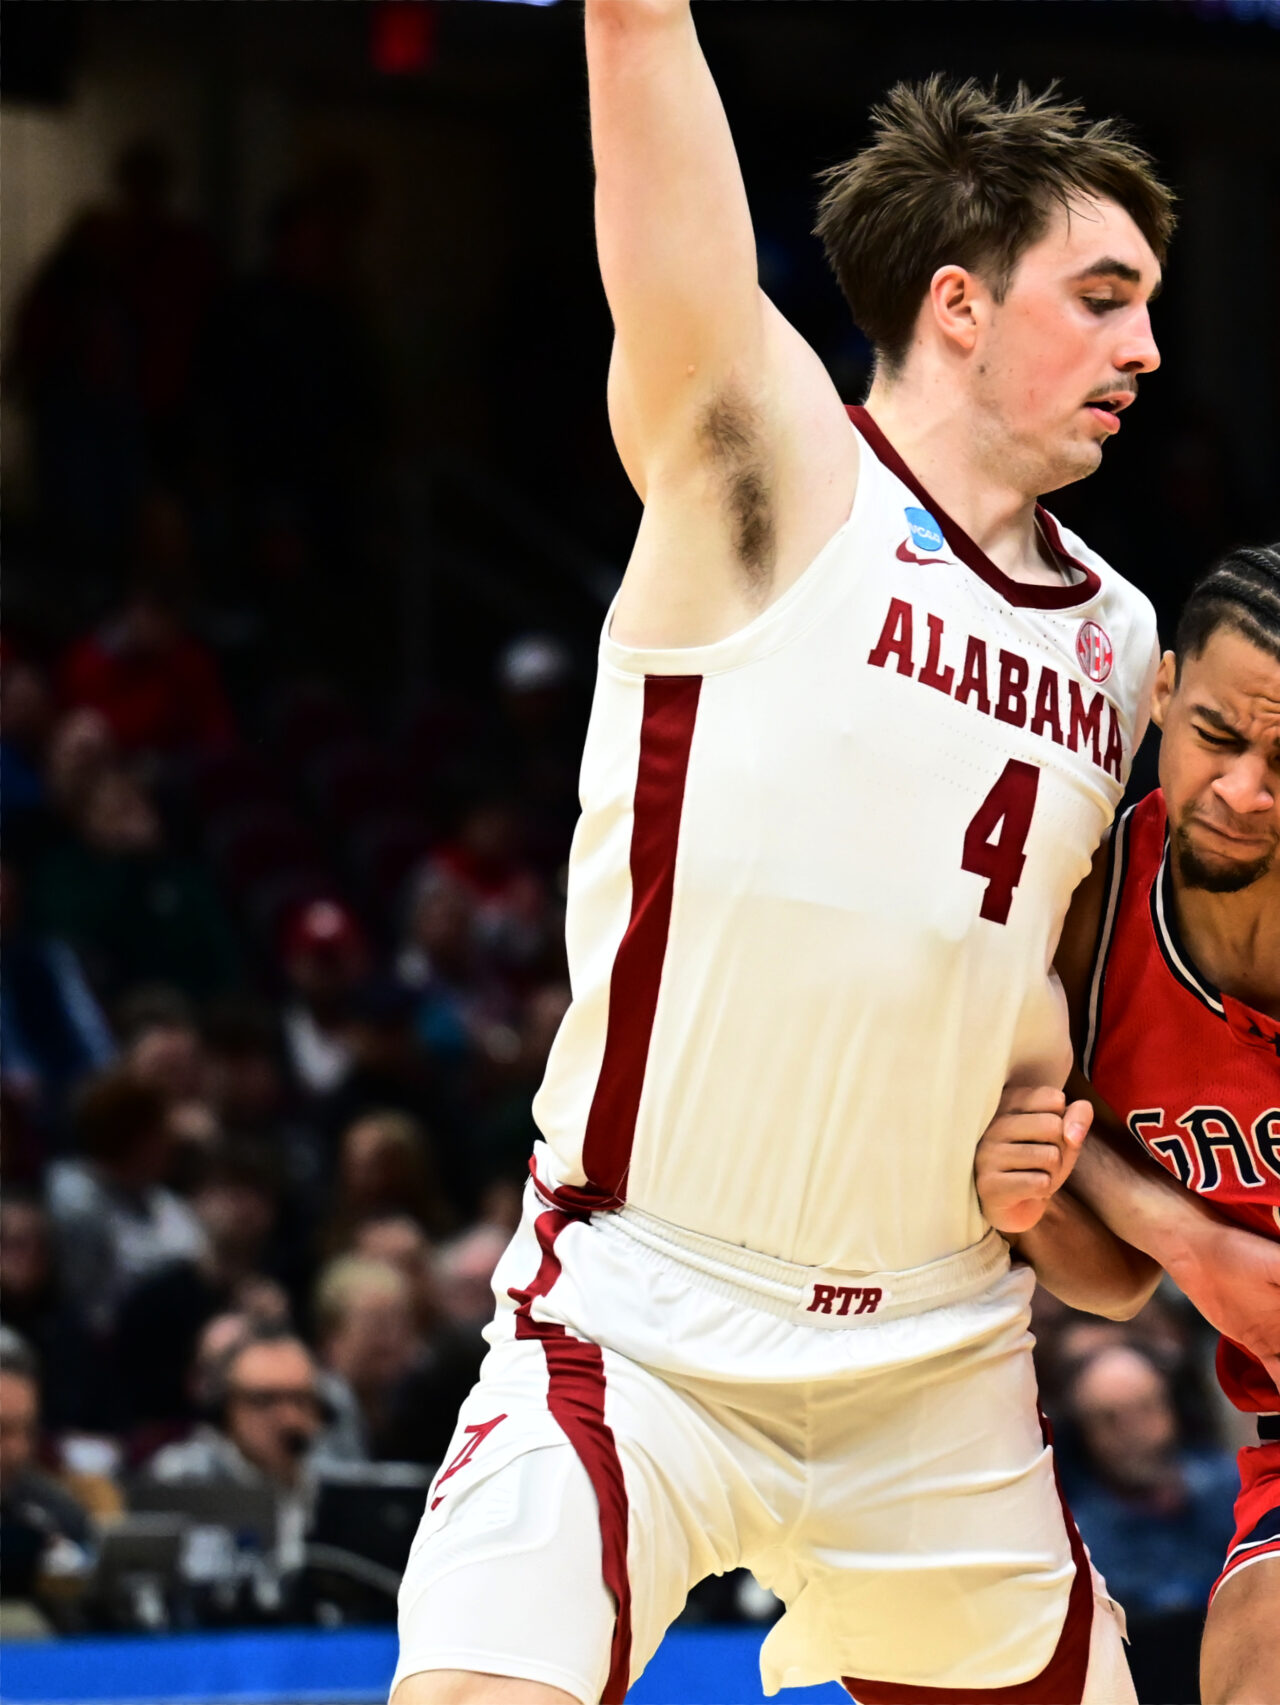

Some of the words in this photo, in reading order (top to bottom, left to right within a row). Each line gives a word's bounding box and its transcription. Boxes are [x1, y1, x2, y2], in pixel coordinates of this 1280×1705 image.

[867, 597, 1122, 783] ALABAMA
[961, 758, 1041, 926] 4
[806, 1283, 883, 1316] RTR
